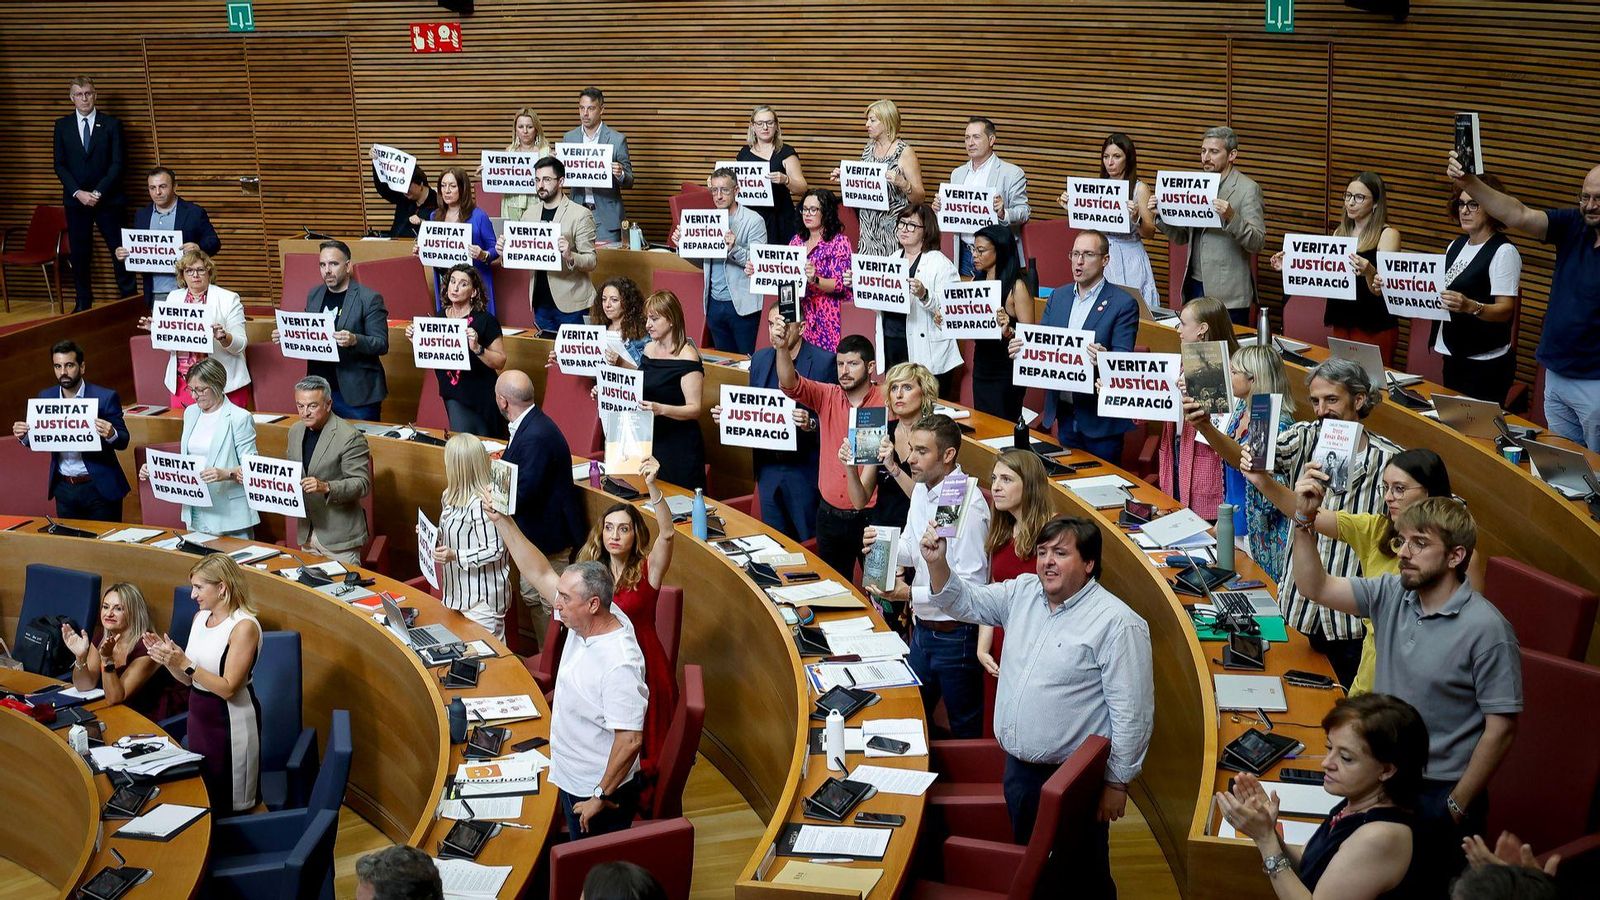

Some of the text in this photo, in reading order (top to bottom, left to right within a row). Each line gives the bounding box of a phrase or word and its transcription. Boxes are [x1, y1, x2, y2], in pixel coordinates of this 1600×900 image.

[563, 148, 605, 156] VERITAT
[488, 156, 530, 164] VERITAT
[379, 160, 405, 174] TÍCIA
[488, 166, 532, 176] JUSTÍCIA
[722, 166, 762, 175] RITAT
[846, 166, 881, 176] VERITAT
[566, 171, 607, 180] EPARACIÓ
[487, 179, 534, 187] REPARACIÓ
[736, 177, 764, 187] TÍCIA
[846, 180, 881, 190] JUSTÍCIA
[1162, 178, 1210, 188] VERITAT
[737, 190, 768, 198] ARACIÓ
[945, 189, 988, 201] VERITAT
[1074, 184, 1120, 195] VERITAT
[845, 192, 883, 202] REPARACIÓ
[1161, 192, 1208, 204] JUSTÍCIA
[945, 202, 989, 214] JUSTÍCIA
[1074, 198, 1121, 210] JUSTÍCIA
[1073, 213, 1124, 224] REPARACIÓ
[1162, 209, 1213, 218] REPARACIÓ
[685, 215, 721, 224] VERITAT
[943, 217, 993, 226] REPARACIÓ
[426, 227, 464, 236] VERITAT
[509, 227, 552, 237] VERITAT
[685, 227, 723, 237] JUSTÍCIA
[129, 234, 174, 243] VERITAT
[424, 238, 464, 249] JUSTÍCIA
[510, 238, 554, 250] JUSTÍCIA
[130, 245, 176, 255] JUSTÍCIA
[683, 240, 725, 250] REPARACIÓ
[1293, 242, 1347, 254] VERITAT
[423, 252, 468, 261] REPARACIÓ
[507, 253, 556, 262] REPARACIÓ
[757, 250, 799, 260] VERITAT
[758, 263, 800, 274] JUSTÍCIA
[858, 261, 901, 273] VERITAT
[1291, 258, 1346, 272] JUSTÍCIA
[1385, 260, 1436, 272] VERITAT
[756, 278, 802, 288] REPAR
[858, 276, 902, 289] JUSTÍCIA
[1289, 276, 1349, 288] REPARACIÓ
[1386, 276, 1437, 292] JUSTÍCIA
[857, 291, 904, 303] REPARACIÓ
[944, 287, 991, 299] VERITAT
[945, 301, 992, 314] JUSTÍCIA
[1387, 296, 1441, 308] REPARACIÓ
[158, 307, 204, 318] VERITAT
[158, 318, 204, 331] JUSTÍCIA
[282, 317, 325, 327] VERITAT
[946, 318, 996, 329] REPARACIÓ
[420, 323, 459, 333] VERITAT
[156, 334, 207, 344] REPARACIÓ
[284, 328, 328, 340] JUSTÍCIA
[562, 330, 599, 340] VERITAT
[1024, 331, 1083, 348] VERITAT
[419, 334, 460, 348] JUSTÍCIA
[285, 342, 332, 353] REPARACIÓ
[560, 342, 601, 354] JUSTÍCIA
[418, 351, 464, 361] REPARACIÓ
[1022, 349, 1083, 365] JUSTÍCIA
[561, 358, 606, 368] REPARAC
[1107, 359, 1168, 372] VERITAT
[601, 371, 635, 386] VERITAT
[1019, 366, 1086, 382] REPARACIÓ
[1110, 376, 1170, 391] JUSTÍCIA
[602, 386, 636, 402] JUSTÍCIA
[729, 393, 785, 407] VERITAT
[1105, 396, 1172, 409] REPARACIÓ
[36, 405, 88, 414] VERITAT
[601, 402, 637, 412] REPAR
[728, 408, 785, 424] JUSTÍCIA
[35, 417, 89, 428] JUSTÍCIA
[34, 433, 94, 442] REPARACIÓ
[726, 426, 789, 440] REPARACIÓ
[152, 456, 195, 470] VERITAT
[249, 462, 293, 477] VERITAT
[154, 470, 198, 485] JUSTÍCIA
[249, 477, 294, 493] JUSTÍCIA
[155, 484, 204, 498] REPARACIÓ
[249, 493, 298, 507] REPARACIÓ
